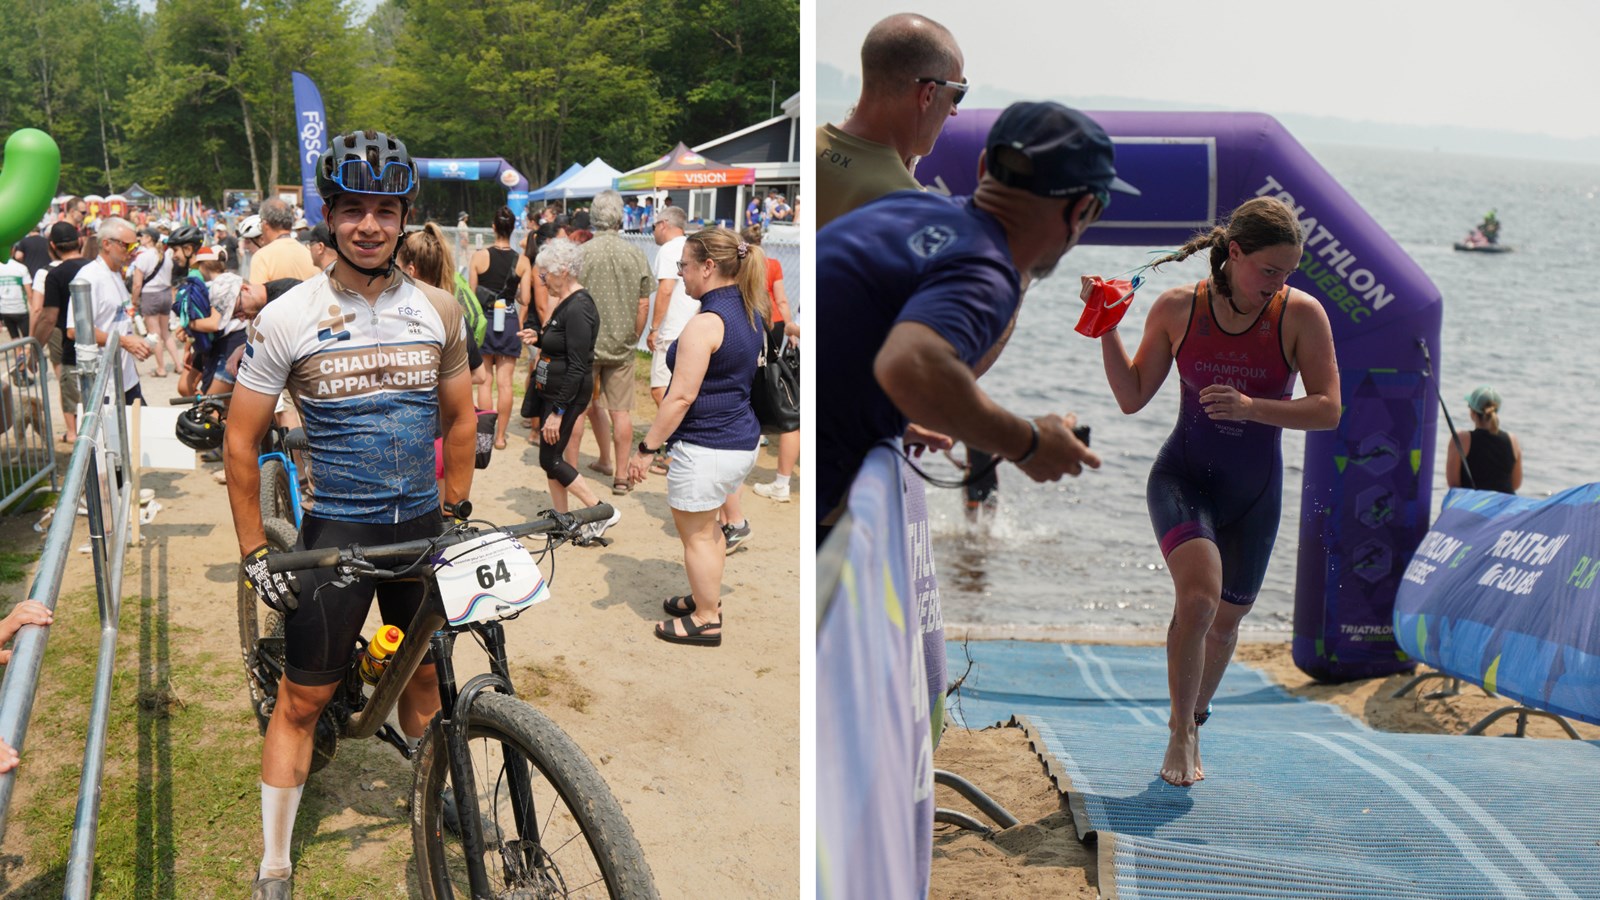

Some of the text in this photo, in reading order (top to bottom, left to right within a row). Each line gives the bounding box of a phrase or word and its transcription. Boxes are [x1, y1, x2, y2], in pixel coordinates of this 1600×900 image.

[302, 111, 324, 165] FQSC
[820, 148, 852, 168] FOX
[684, 171, 728, 184] VISION
[319, 348, 436, 375] CHAUDIÈRE-
[1194, 360, 1268, 379] CHAMPOUX
[317, 368, 438, 395] APPALACHES
[1213, 374, 1248, 391] CAN
[475, 558, 511, 590] 64
